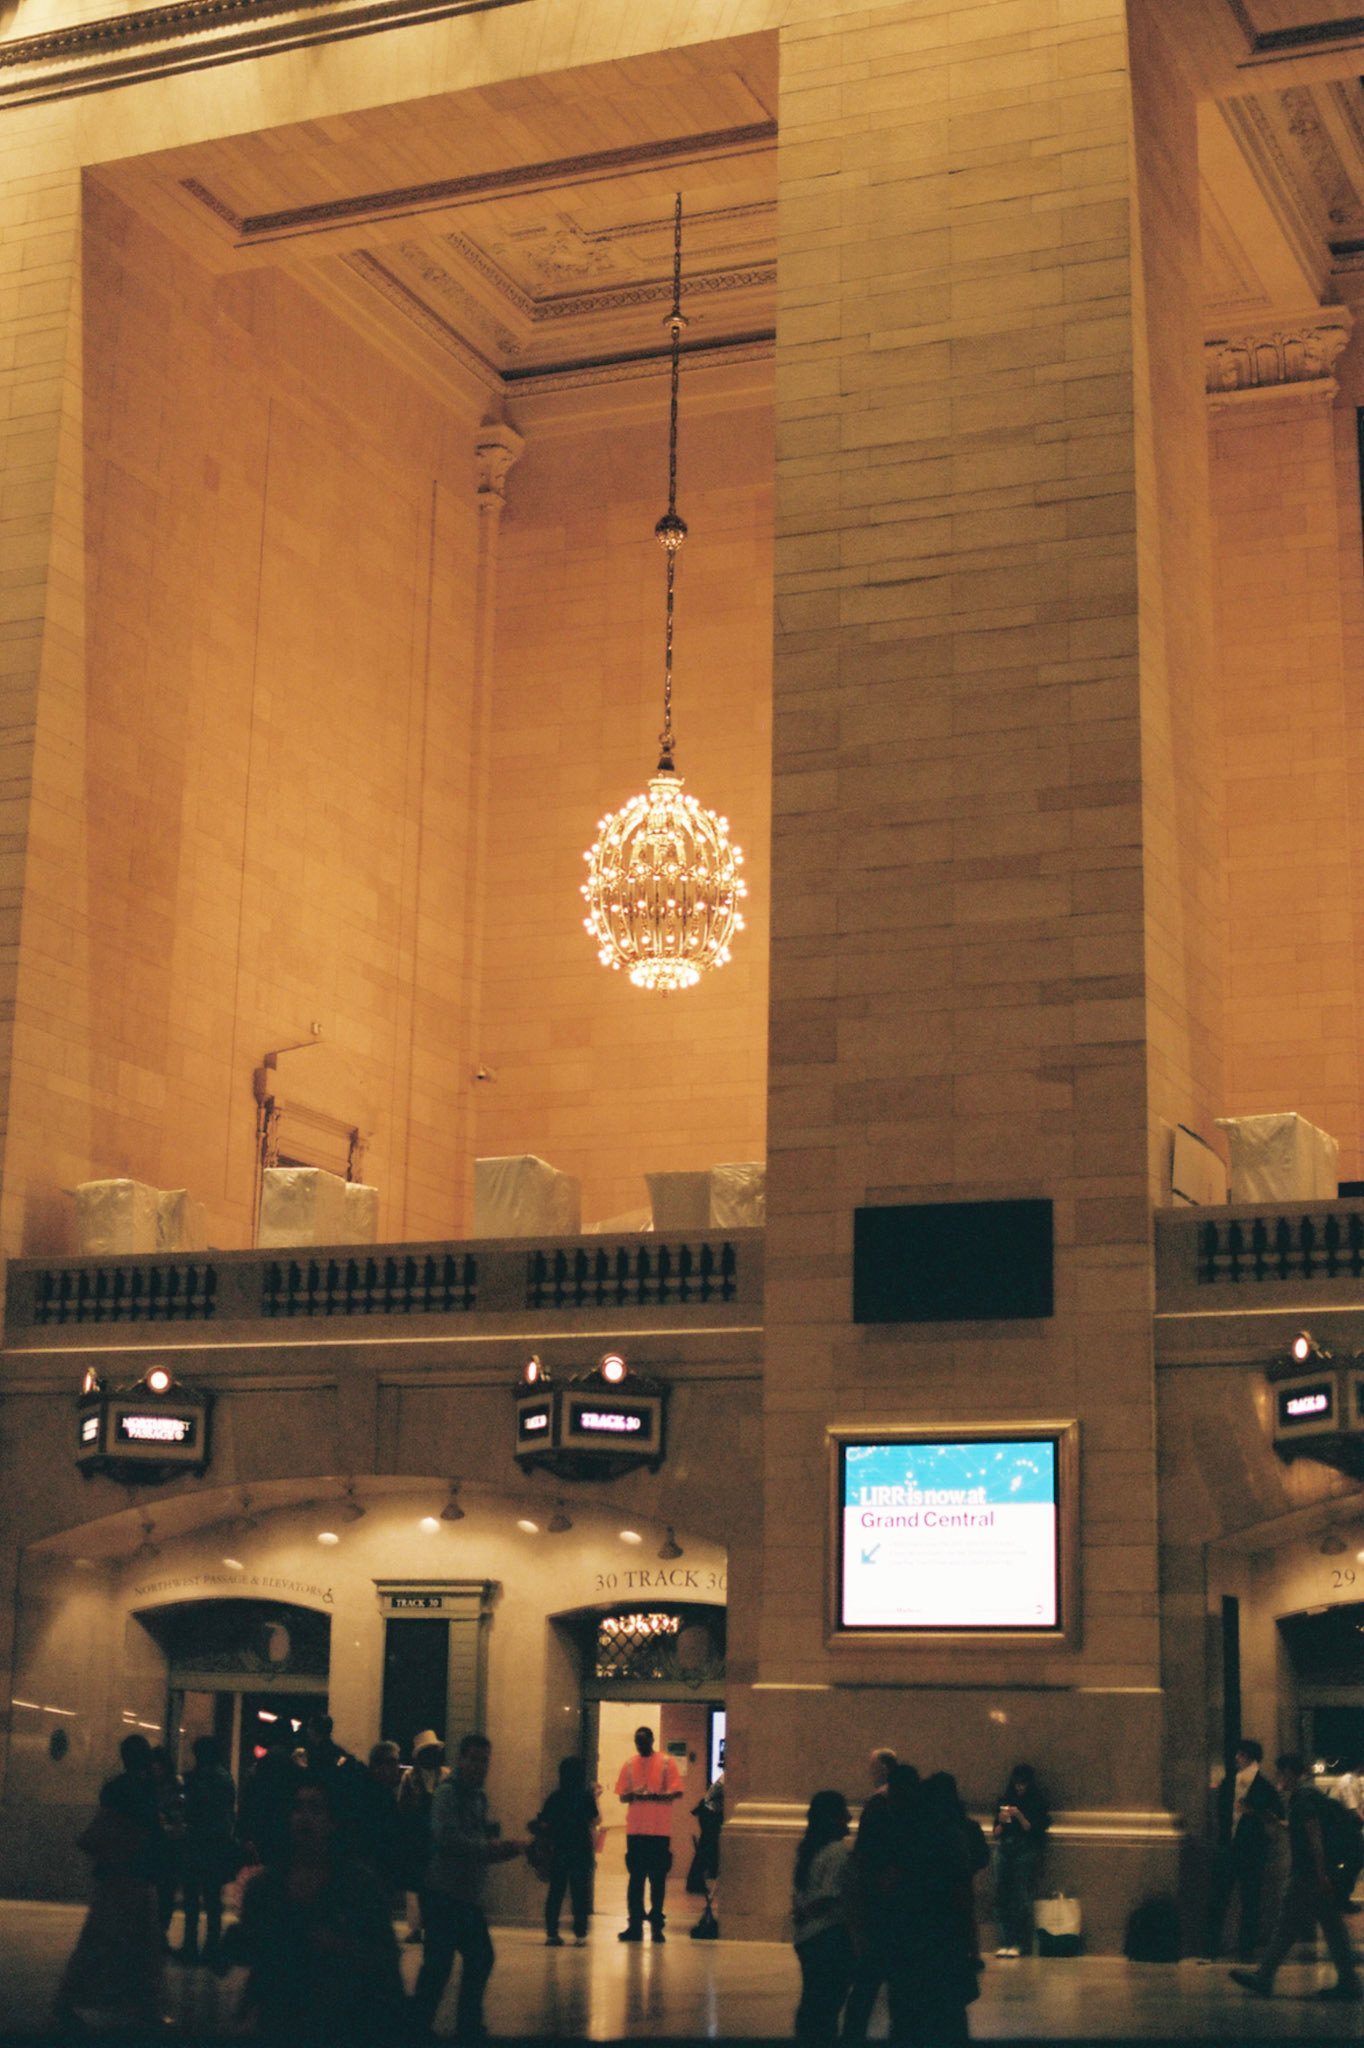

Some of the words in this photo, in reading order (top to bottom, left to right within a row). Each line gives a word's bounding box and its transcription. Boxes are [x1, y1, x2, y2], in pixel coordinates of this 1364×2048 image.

[581, 1412, 625, 1431] TRACK
[626, 1416, 641, 1431] 30
[860, 1486, 905, 1505] LIRR
[906, 1484, 923, 1505] is
[924, 1488, 967, 1505] now
[968, 1486, 987, 1505] at
[861, 1512, 919, 1527] Grand
[923, 1511, 994, 1527] Central
[134, 1575, 200, 1596] NORTHWEST
[203, 1575, 249, 1585] PASSAGE
[251, 1575, 259, 1585] &
[262, 1578, 322, 1596] ELEVATORS
[595, 1574, 618, 1591] 30
[624, 1569, 699, 1588] TRACK
[1331, 1568, 1356, 1588] 29
[396, 1599, 424, 1608] TRACK
[429, 1599, 439, 1608] 30
[601, 1613, 680, 1634] NORTH
